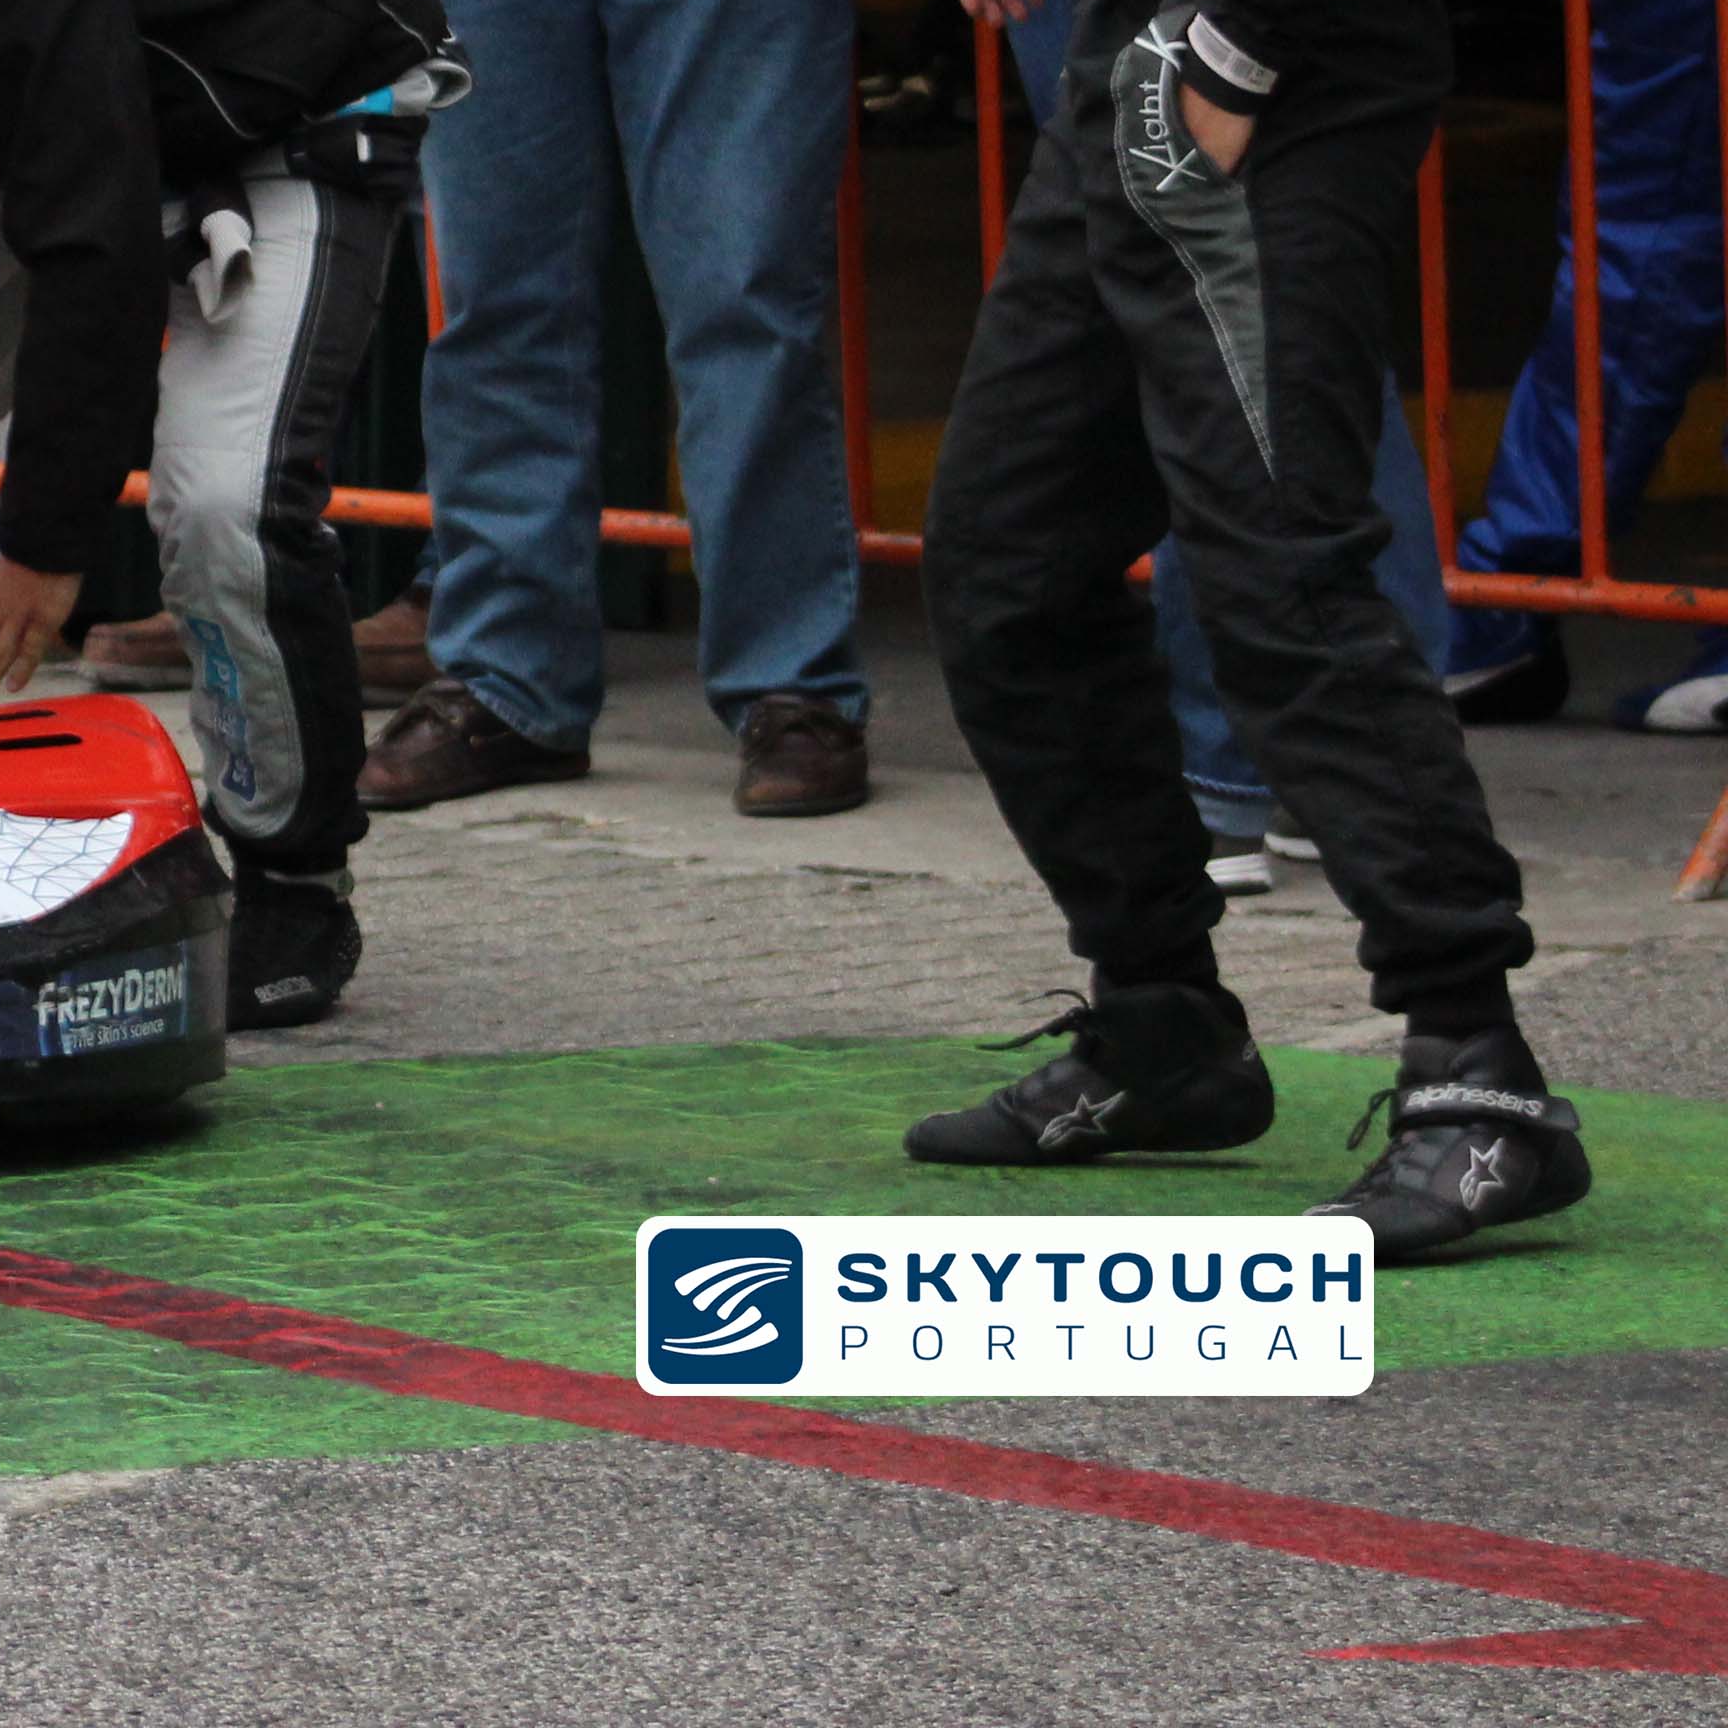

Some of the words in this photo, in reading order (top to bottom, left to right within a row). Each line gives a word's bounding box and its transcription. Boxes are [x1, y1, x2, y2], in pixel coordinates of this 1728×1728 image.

[70, 1027, 93, 1049] The
[96, 1022, 128, 1047] skin's
[130, 1017, 165, 1041] science
[1406, 1082, 1545, 1118] alpinestars
